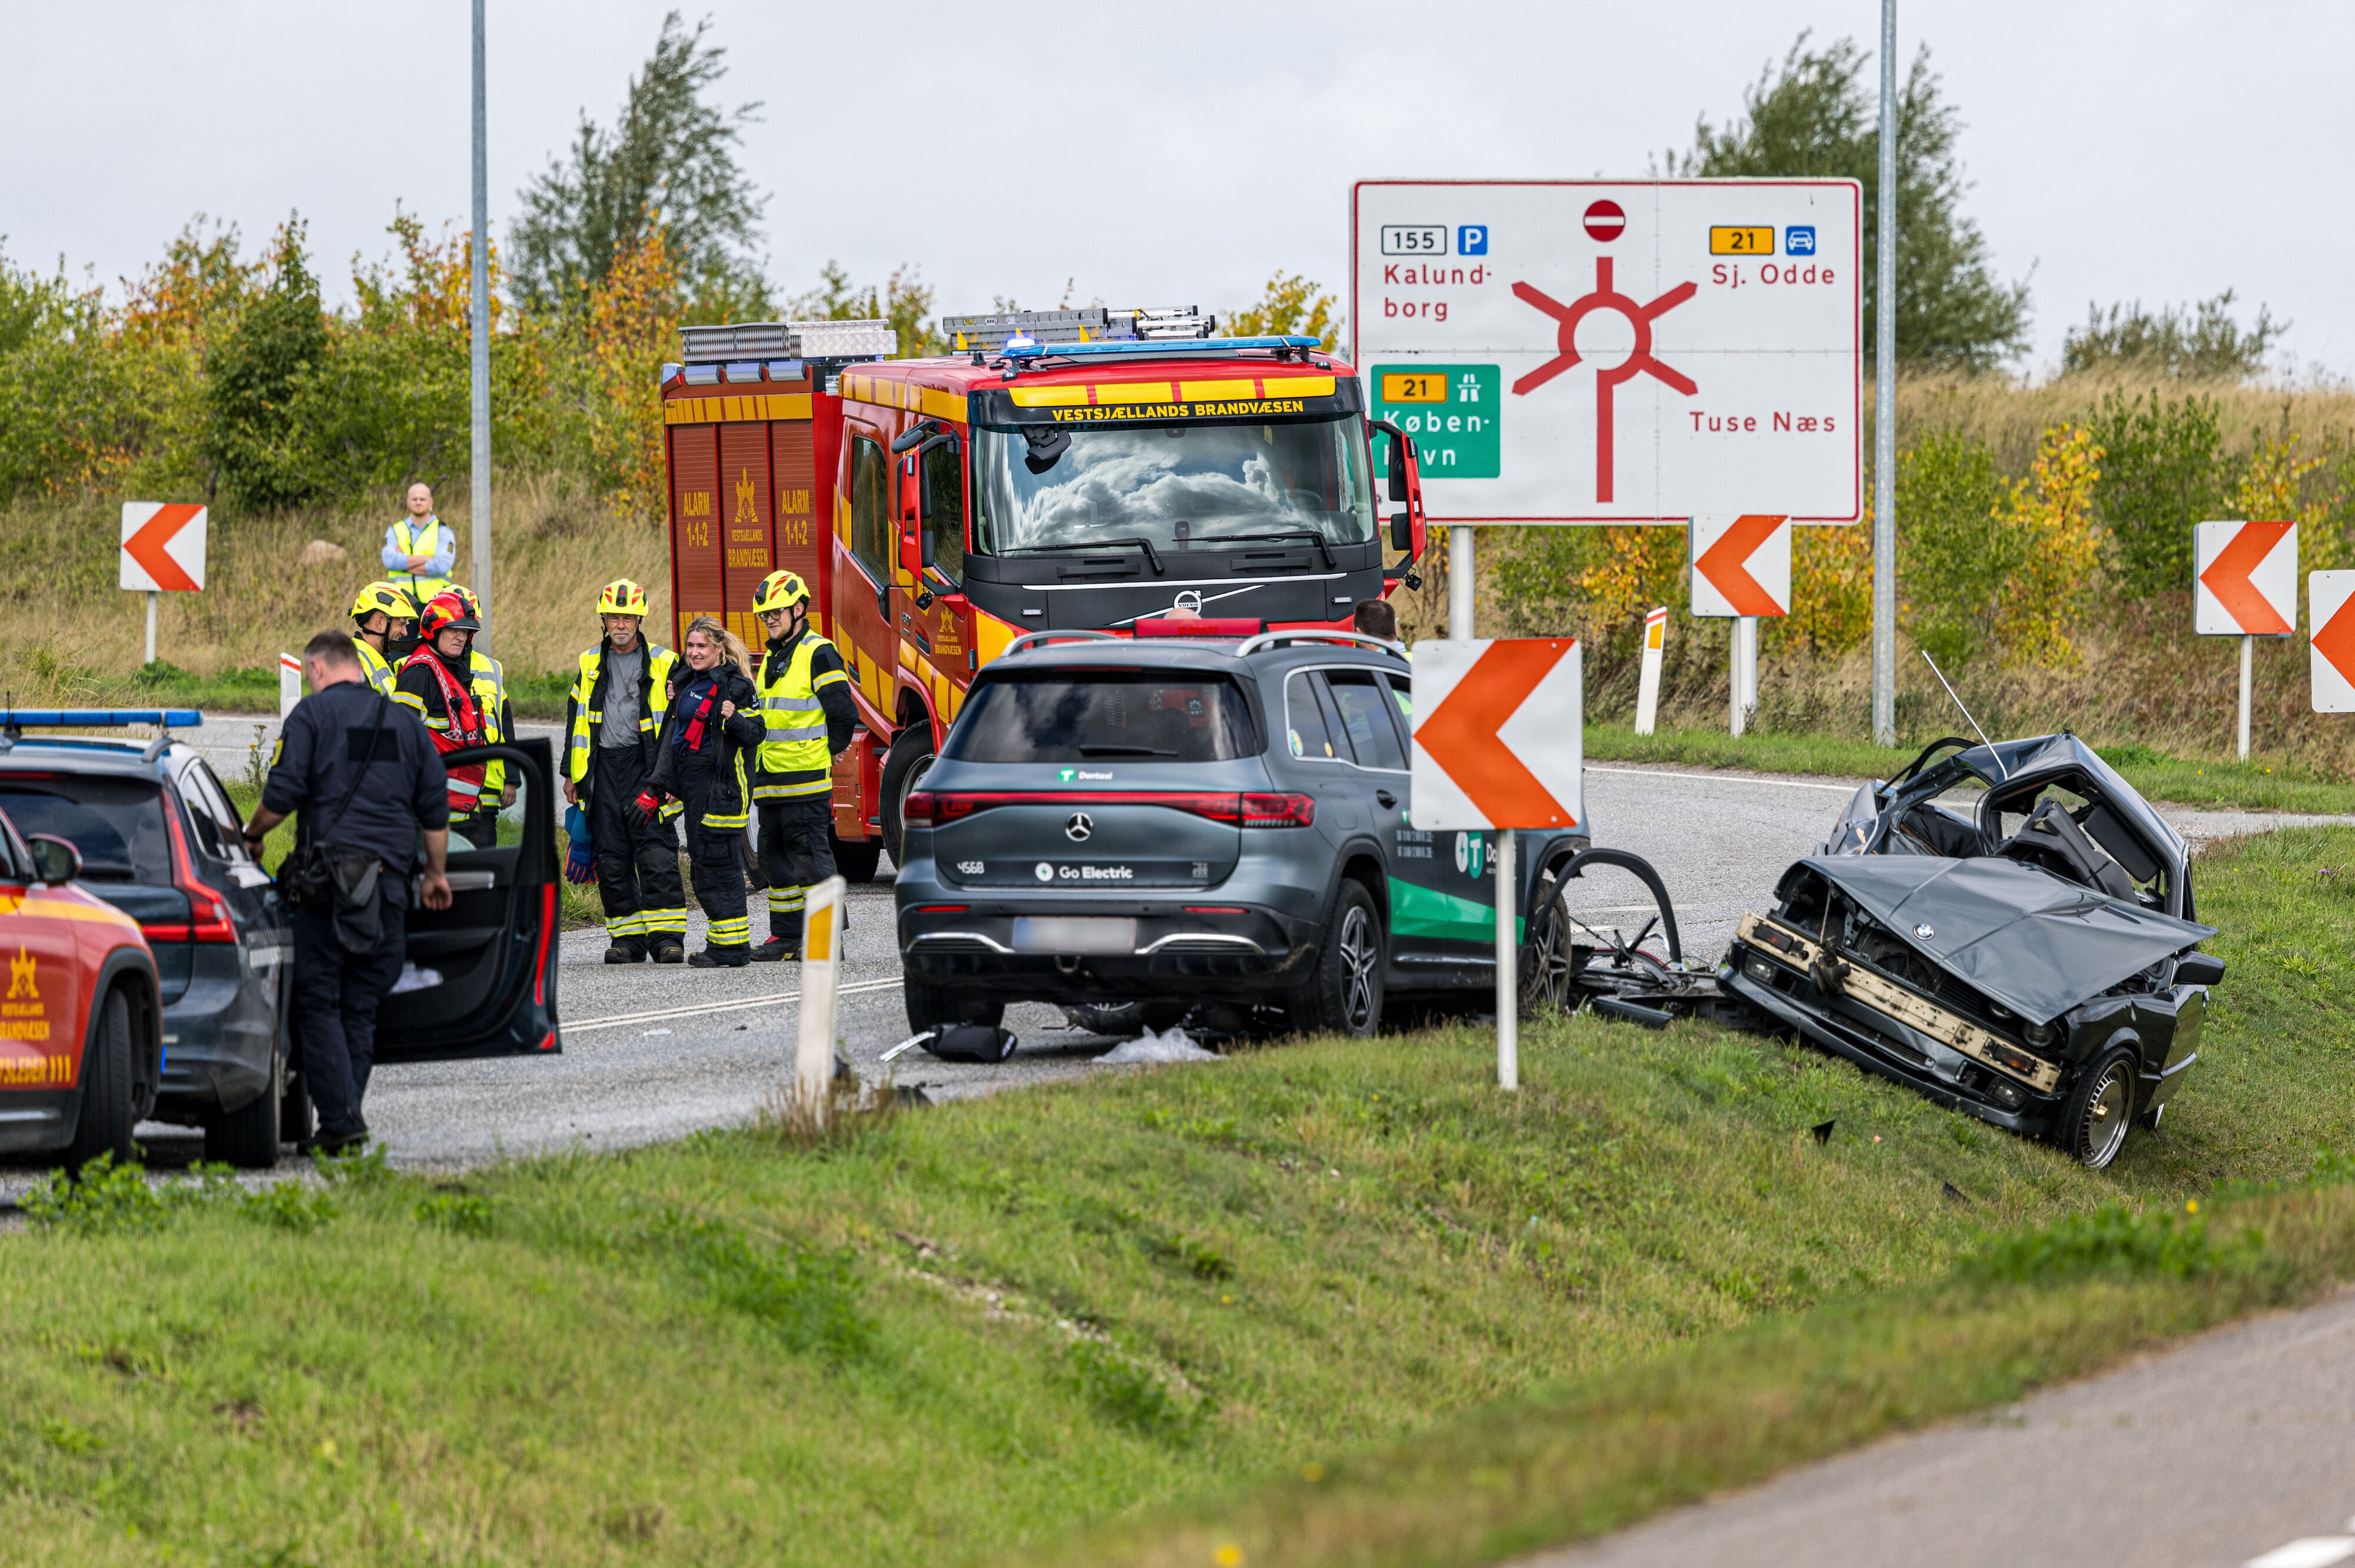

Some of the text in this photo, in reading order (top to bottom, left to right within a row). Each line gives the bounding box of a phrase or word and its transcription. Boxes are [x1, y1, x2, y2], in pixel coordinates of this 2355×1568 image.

[1394, 231, 1434, 249] 155
[1465, 228, 1482, 253] P
[1731, 232, 1754, 250] 21
[1384, 264, 1492, 284] Kalund-
[1712, 263, 1835, 288] Sj. Odde
[1384, 297, 1448, 321] borg
[1404, 379, 1427, 396] 21
[1052, 404, 1189, 421] VESTSJÆLLANDS
[1195, 400, 1303, 417] BRANDVÆSEN
[1689, 411, 1835, 432] Tuse Næs
[684, 491, 710, 516] ALARM
[782, 490, 810, 514] ALARM
[686, 521, 708, 546] 1-1-2
[785, 520, 808, 545] 1-1-2
[728, 548, 768, 567] BRANDVÆSEN
[935, 644, 961, 655] BRANDVÆSEN
[1059, 866, 1133, 879] Go Electric
